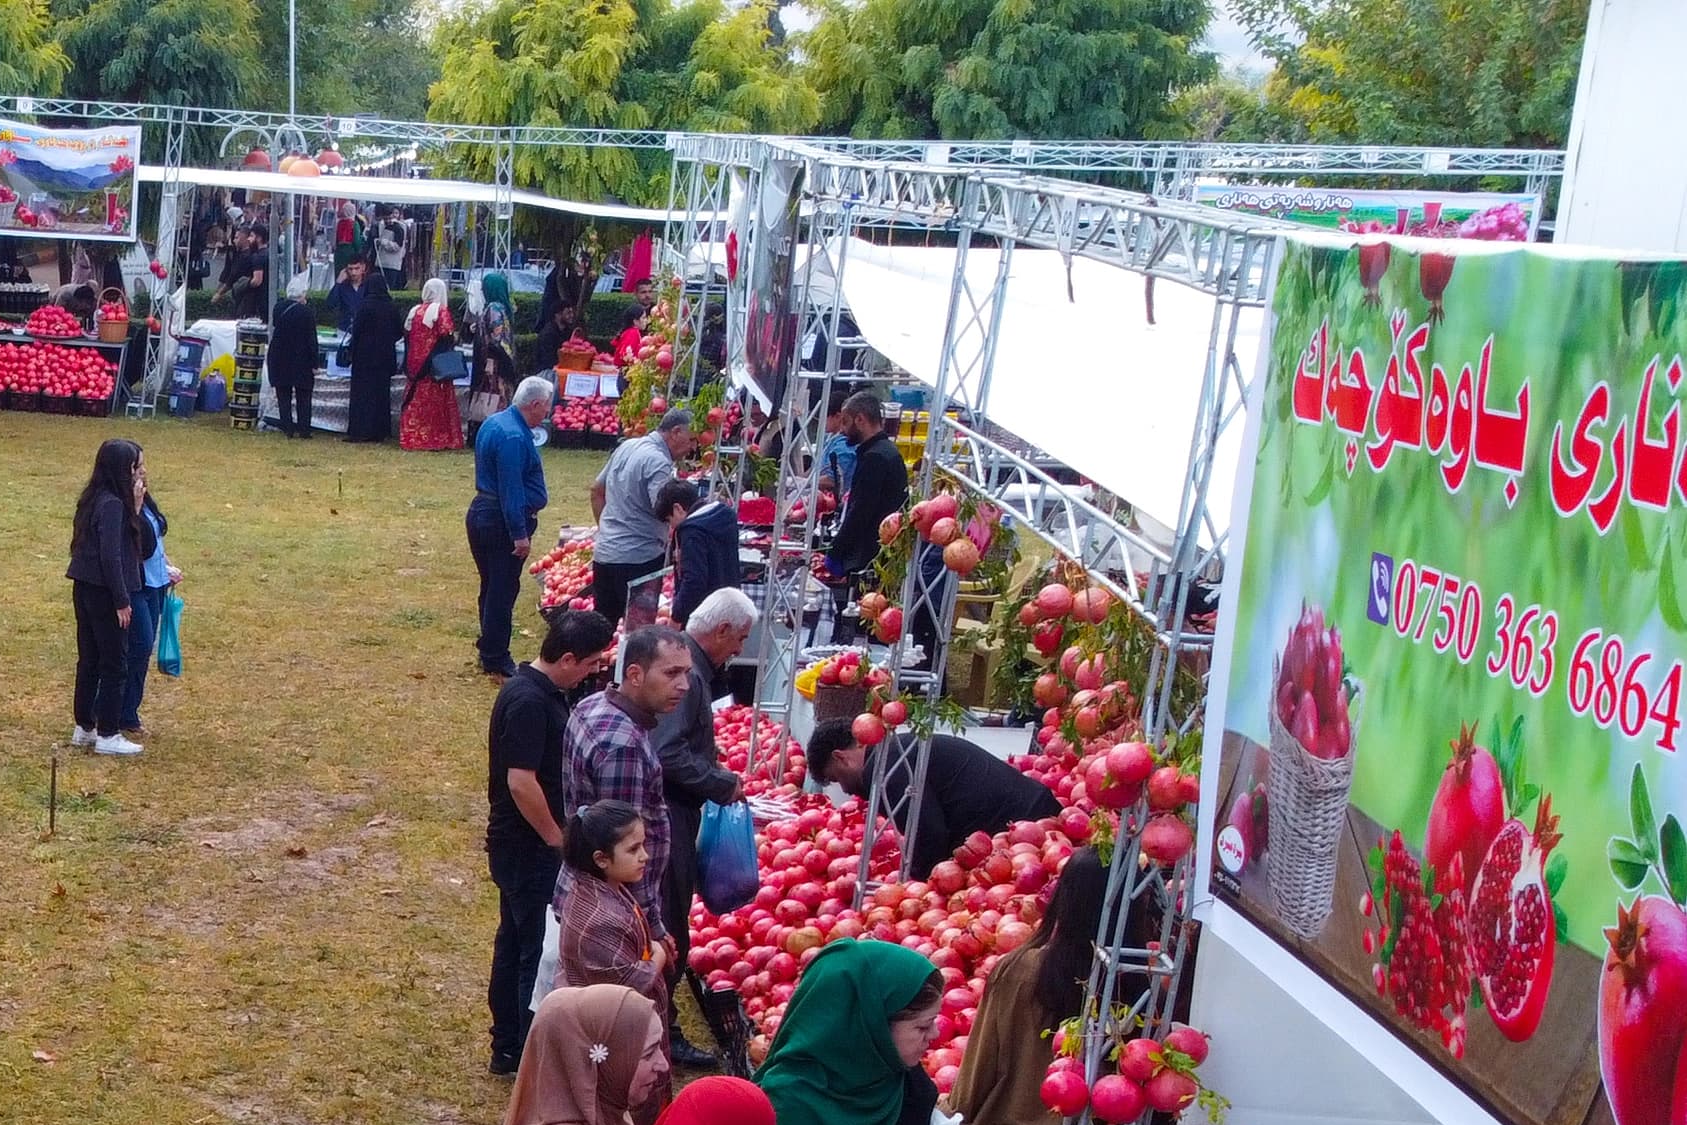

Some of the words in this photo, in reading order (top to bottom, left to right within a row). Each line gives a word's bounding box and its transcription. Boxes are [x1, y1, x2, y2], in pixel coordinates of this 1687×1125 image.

[1392, 559, 1482, 665] 0750
[1486, 592, 1559, 696] 363
[1567, 626, 1683, 753] 6864
